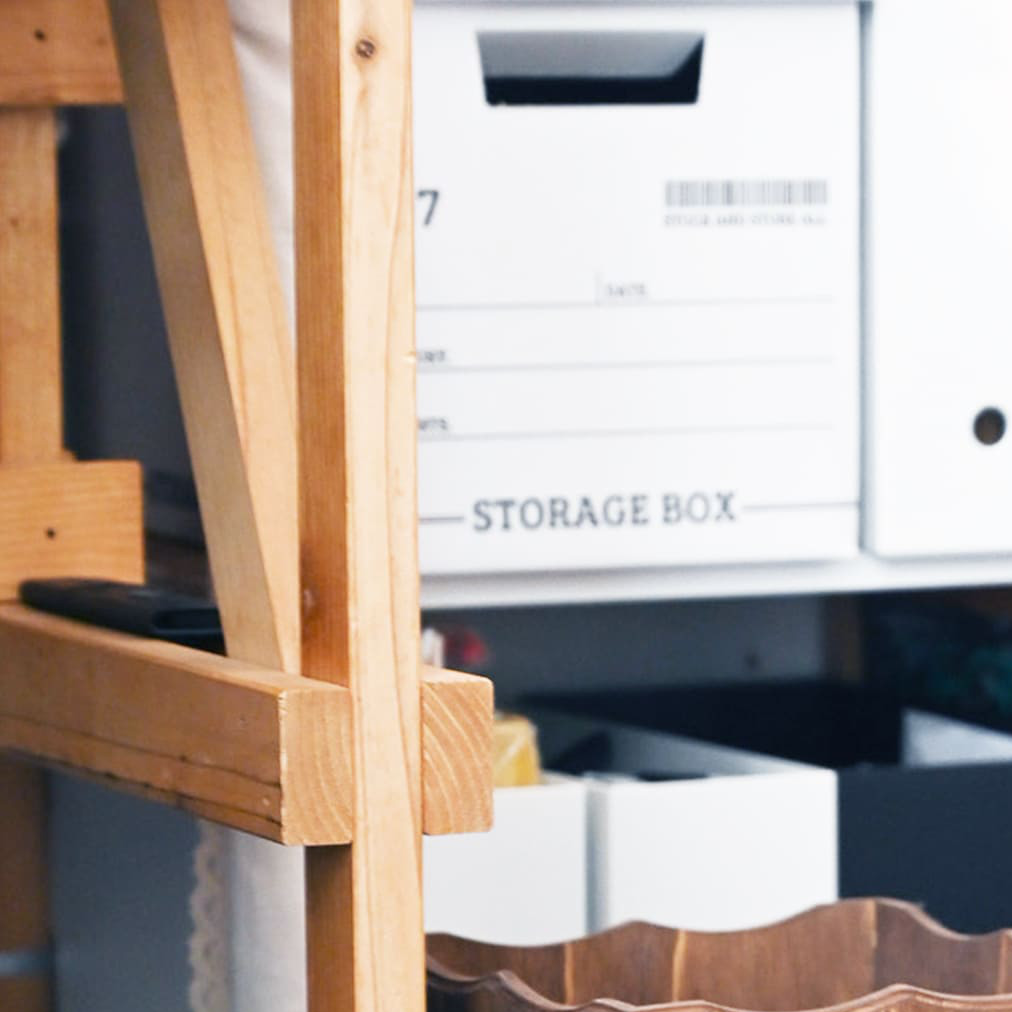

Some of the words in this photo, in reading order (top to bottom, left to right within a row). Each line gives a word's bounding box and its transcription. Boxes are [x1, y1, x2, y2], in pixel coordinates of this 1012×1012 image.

[418, 189, 440, 228] 7
[472, 494, 649, 531] STORAGE
[661, 491, 735, 525] BOX
